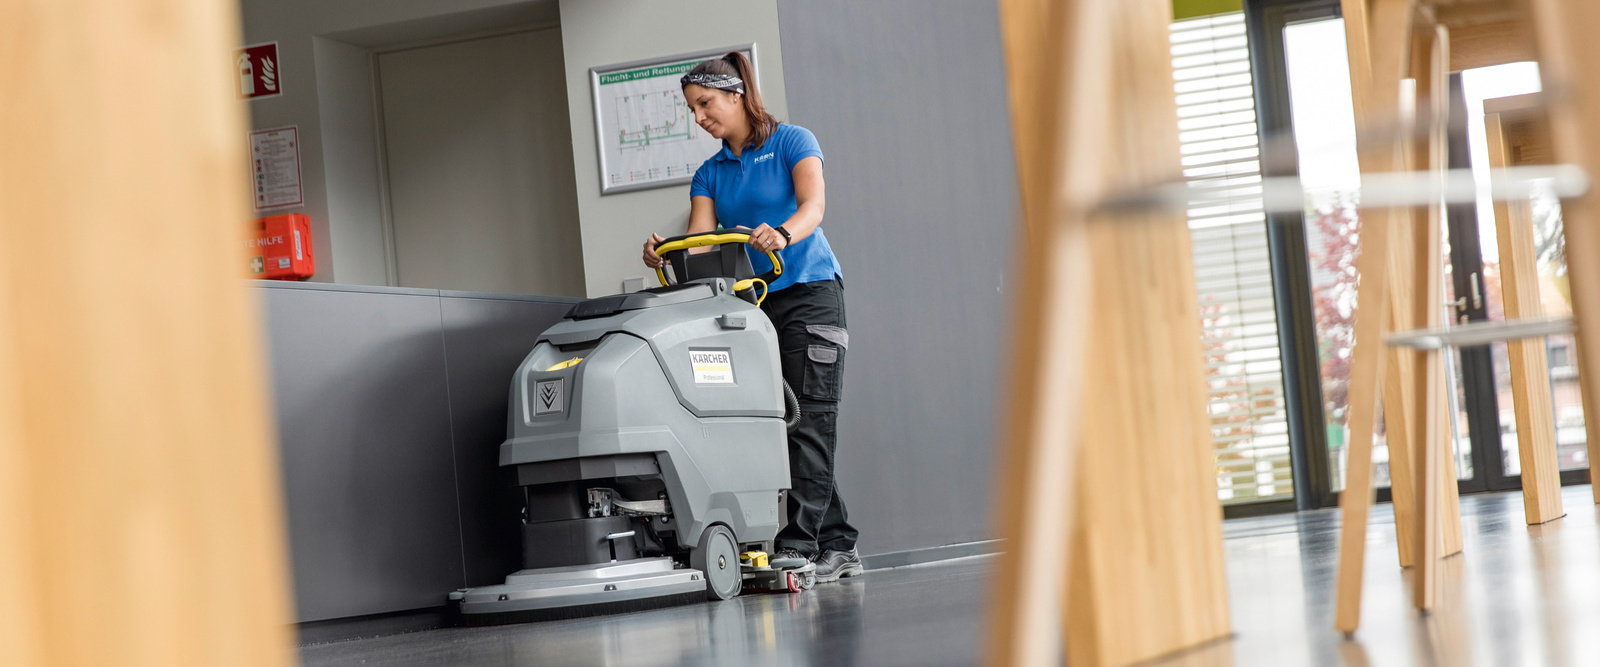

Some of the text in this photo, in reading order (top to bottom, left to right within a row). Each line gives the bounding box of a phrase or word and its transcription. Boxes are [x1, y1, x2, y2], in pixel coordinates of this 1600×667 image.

[601, 73, 631, 83] Flucht-
[633, 69, 650, 79] und
[257, 235, 284, 247] HILFE
